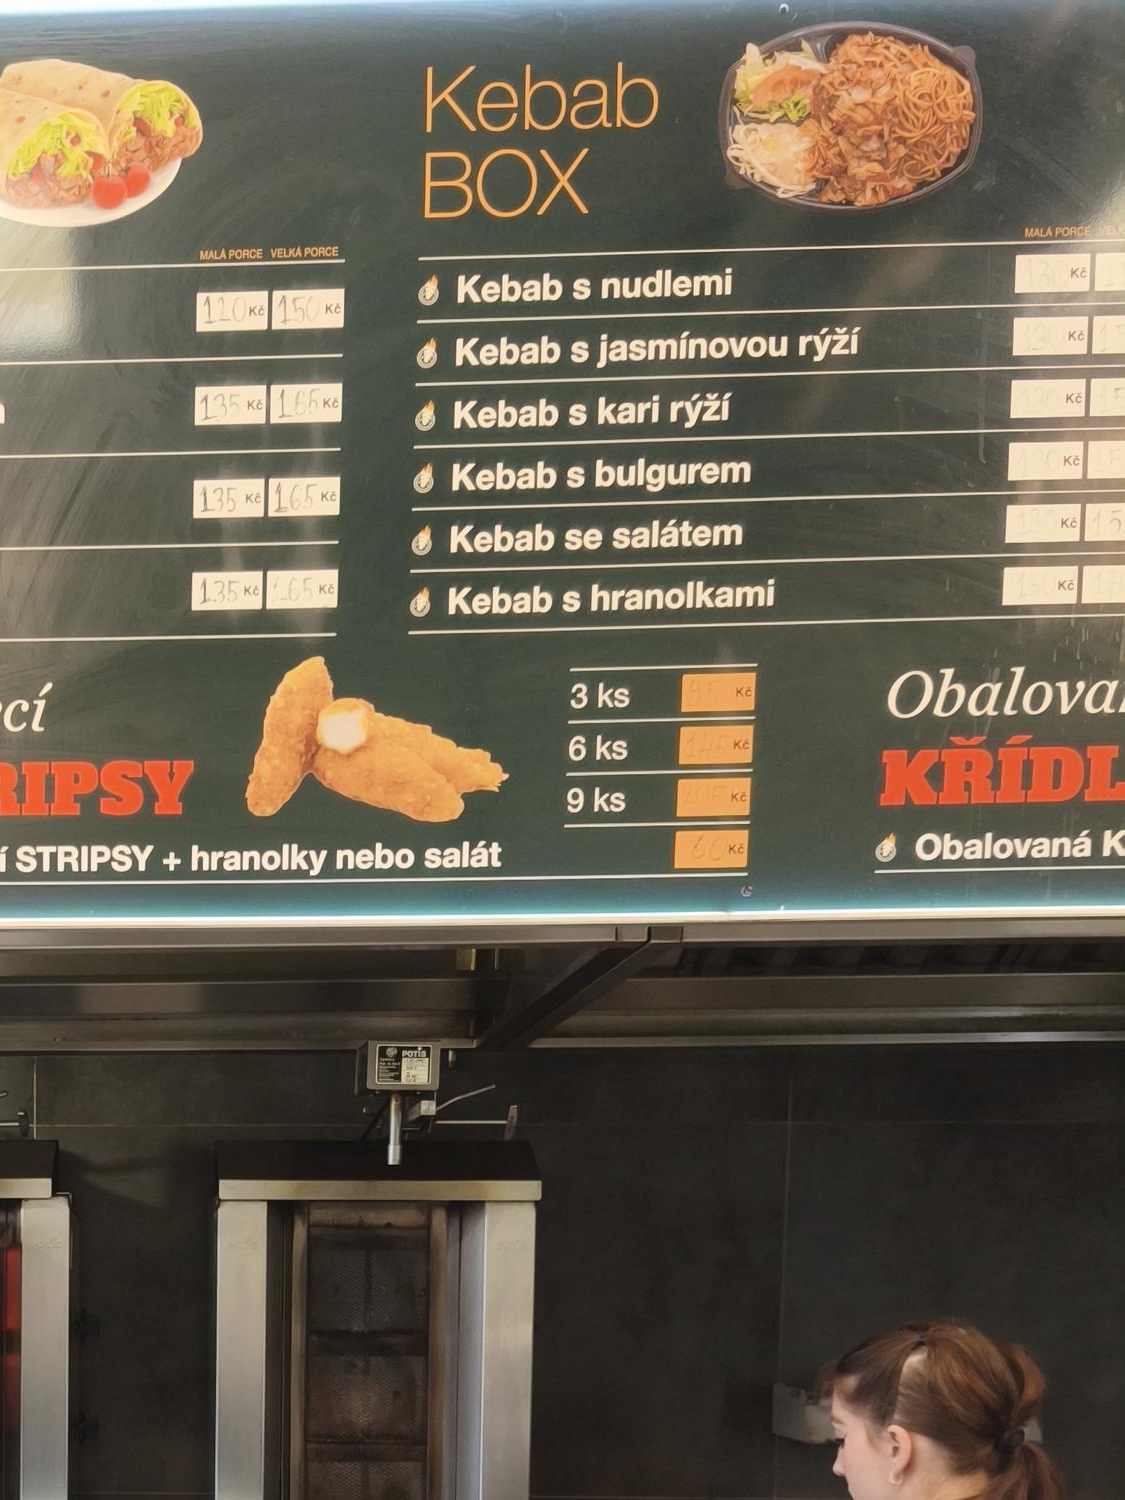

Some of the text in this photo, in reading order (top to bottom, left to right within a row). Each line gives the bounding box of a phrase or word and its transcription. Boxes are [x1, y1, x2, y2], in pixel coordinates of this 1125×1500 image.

[425, 64, 658, 133] Kebab
[423, 148, 587, 219] BOX
[199, 248, 263, 261] MALÁ PORCE
[270, 246, 339, 258] VELKÁ PORCE
[458, 268, 732, 303] Kebab s nudlemi
[1069, 266, 1088, 279] Kč
[248, 305, 266, 316] Kč
[277, 293, 341, 326] 150 Kč
[456, 327, 861, 368] Kebab s jasmínovou rýží
[1068, 329, 1086, 342] Kč
[199, 392, 263, 421] 135 Kč
[323, 397, 339, 408] Kč
[454, 393, 732, 428] Kebab s kari rýží
[1065, 391, 1083, 405] Kč
[1062, 454, 1080, 467] Kč
[452, 458, 750, 492] Kebab s bulgurem
[199, 484, 262, 513] 135 Kč
[273, 480, 337, 513] 165 Kč
[451, 519, 742, 553] Kebab se salátem
[1060, 516, 1078, 529] Kč
[198, 577, 260, 606] 135 Kč
[318, 583, 335, 595] Kč
[449, 579, 774, 614] Kebab s hranolkami
[1057, 578, 1075, 591] Kč
[571, 683, 629, 708] 3 ks
[735, 685, 753, 699] Kč
[888, 667, 1125, 718] Obalova
[569, 735, 627, 761] 6 ks
[733, 737, 750, 750] Kč
[567, 787, 625, 812] 9 ks
[730, 790, 748, 803] Kč
[16, 845, 154, 872] STRIPSY
[163, 852, 181, 871] +
[192, 844, 327, 875] hranolky
[337, 843, 414, 869] nebo
[425, 841, 502, 868] salát
[692, 833, 745, 861] 60 Kč
[916, 830, 1091, 860] Obalovaná
